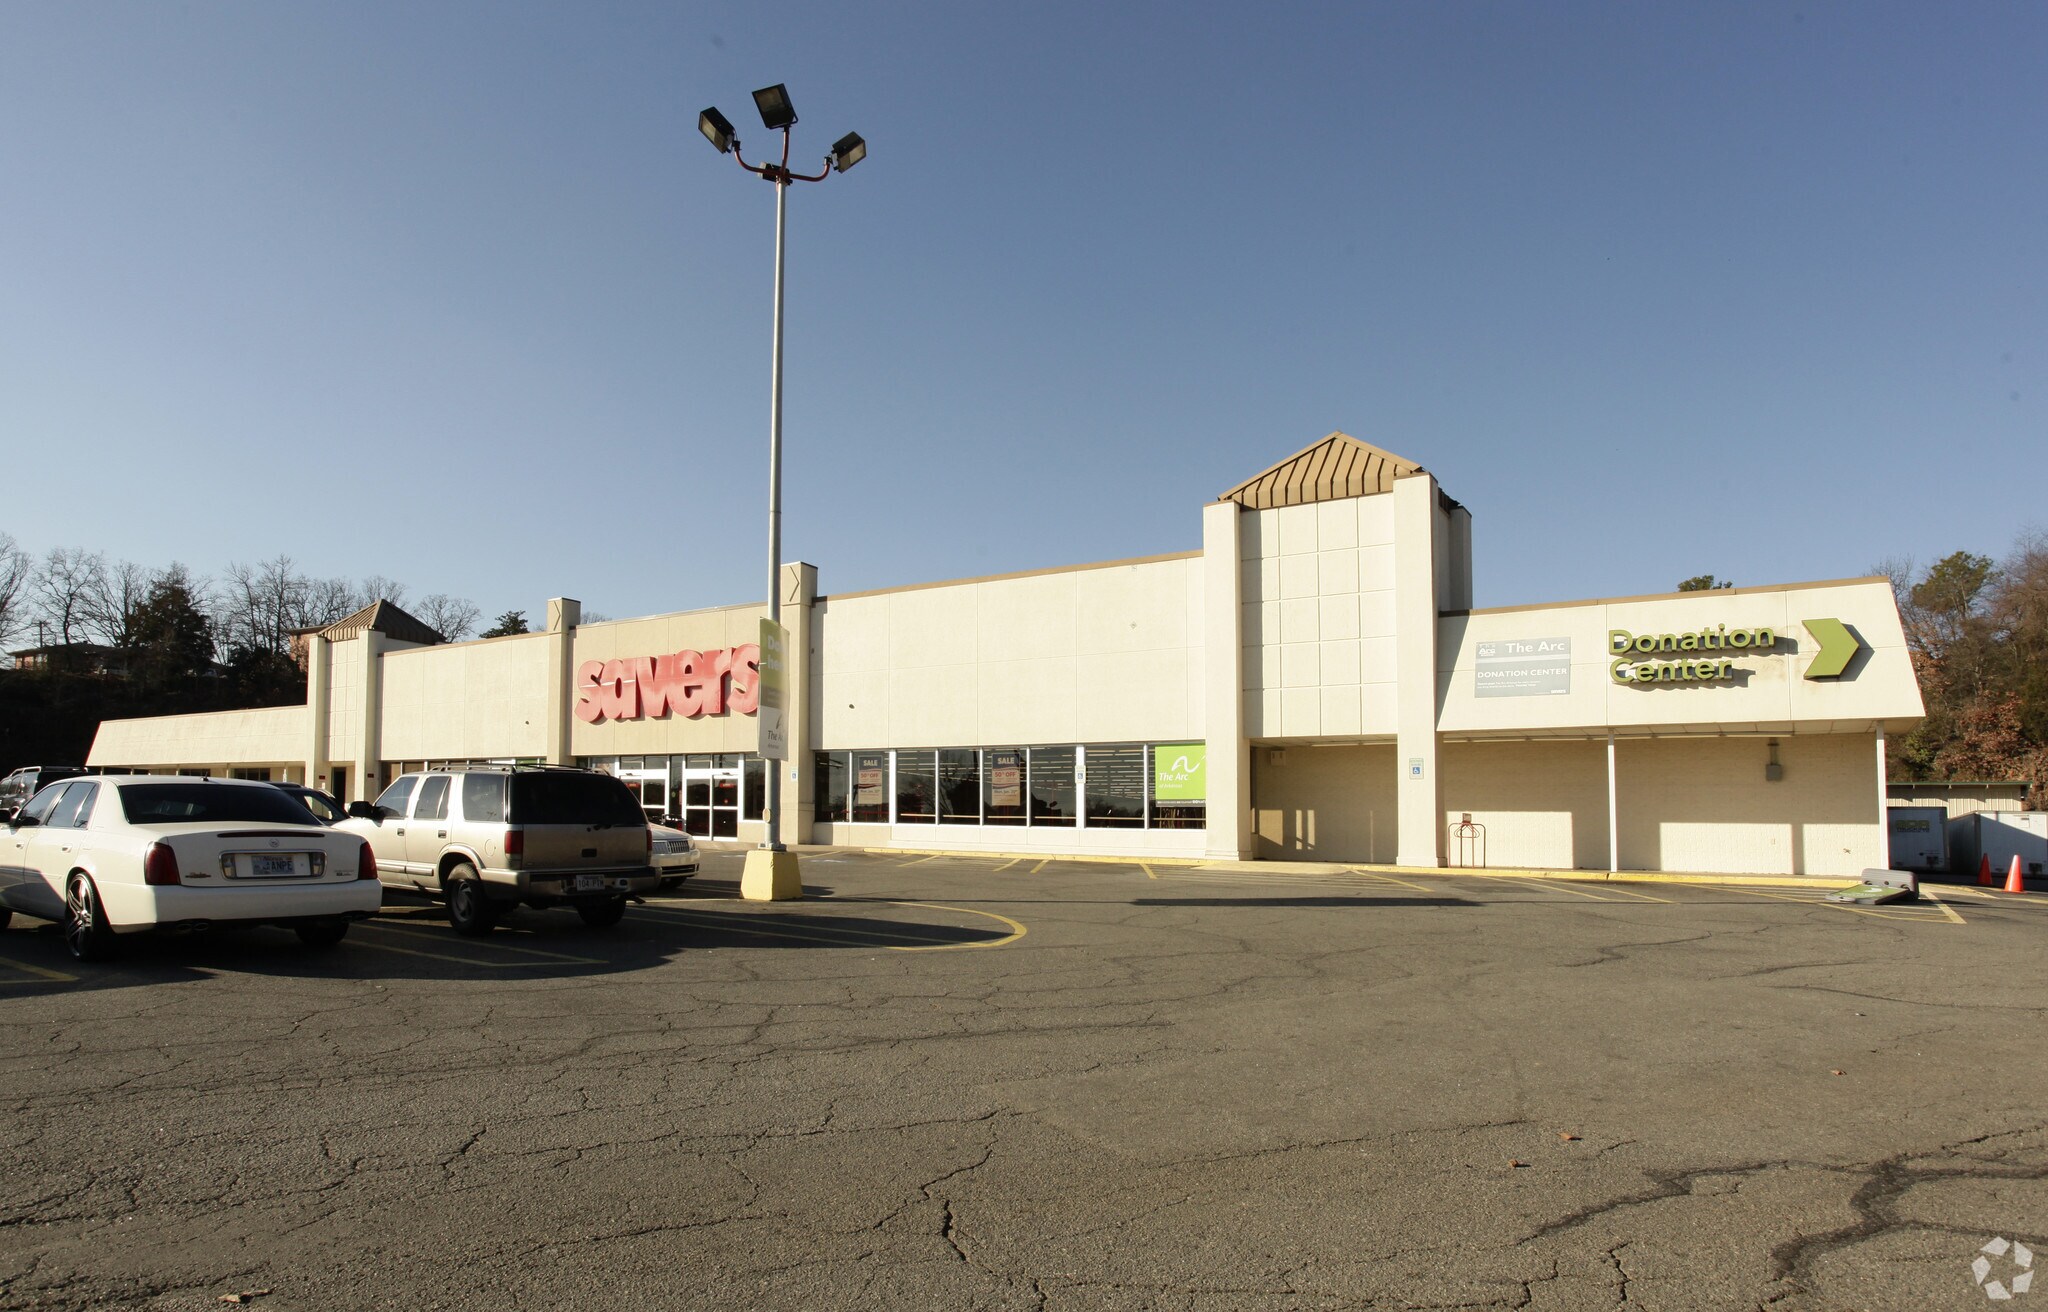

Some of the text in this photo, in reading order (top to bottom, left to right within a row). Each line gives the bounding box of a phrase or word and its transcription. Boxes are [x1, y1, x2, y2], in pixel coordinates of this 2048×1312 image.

[1609, 622, 1775, 654] Donation
[1505, 642, 1534, 654] The
[1537, 640, 1566, 652] Arc
[1477, 668, 1568, 678] DONATION CENTER
[1609, 657, 1733, 683] Center
[574, 643, 760, 722] savers
[863, 759, 878, 767] SALE
[997, 757, 1015, 765] SALE
[1159, 772, 1189, 782] The Arc
